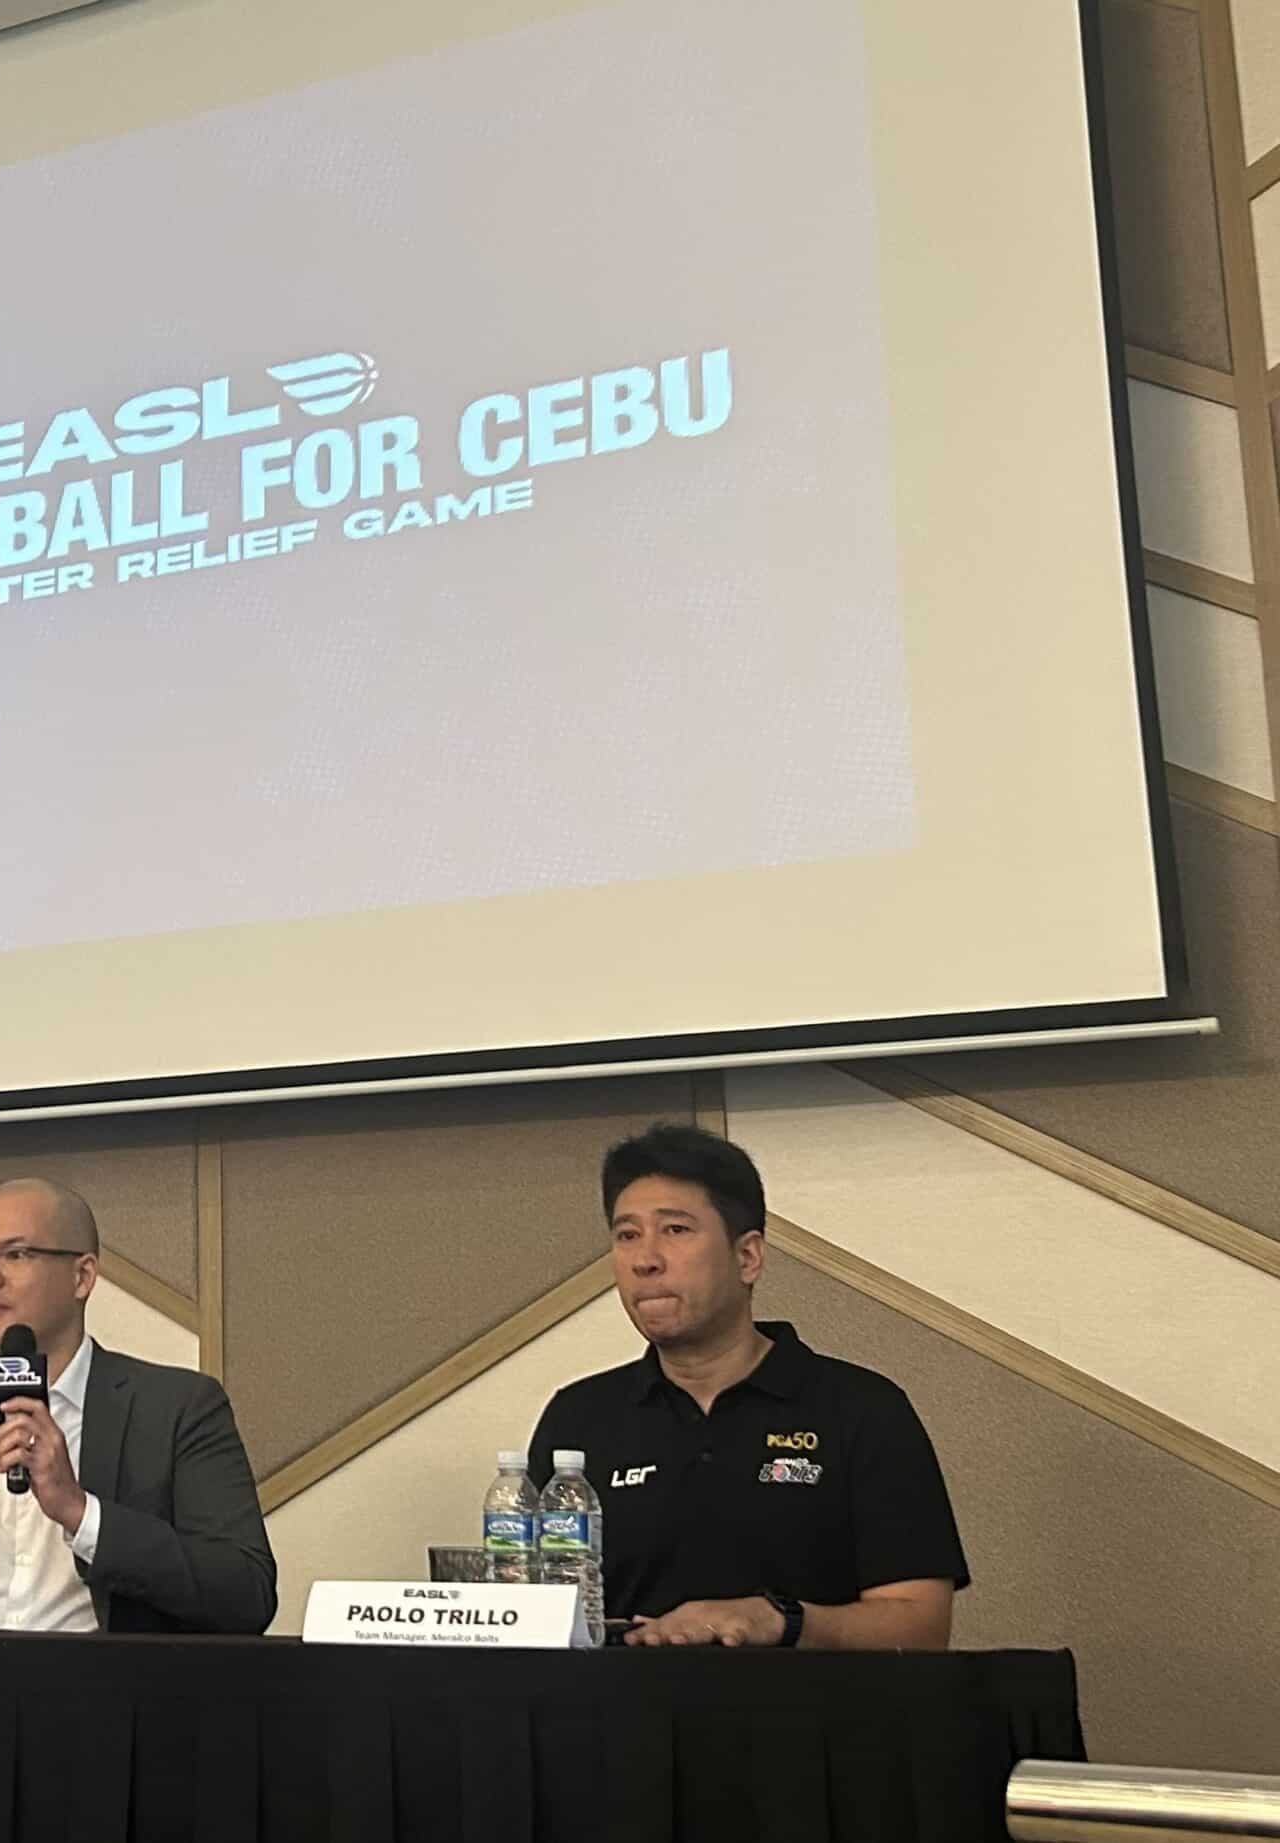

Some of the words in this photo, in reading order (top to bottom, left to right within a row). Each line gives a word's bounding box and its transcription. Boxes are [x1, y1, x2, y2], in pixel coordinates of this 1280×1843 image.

[241, 416, 422, 520] FOR
[458, 349, 732, 477] CEBU
[116, 520, 317, 583] RELIEF
[342, 481, 531, 539] GAME
[403, 1588, 449, 1599] EASL
[347, 1605, 426, 1624] PAOLO
[434, 1609, 519, 1626] TRILLO
[354, 1630, 380, 1640] Team
